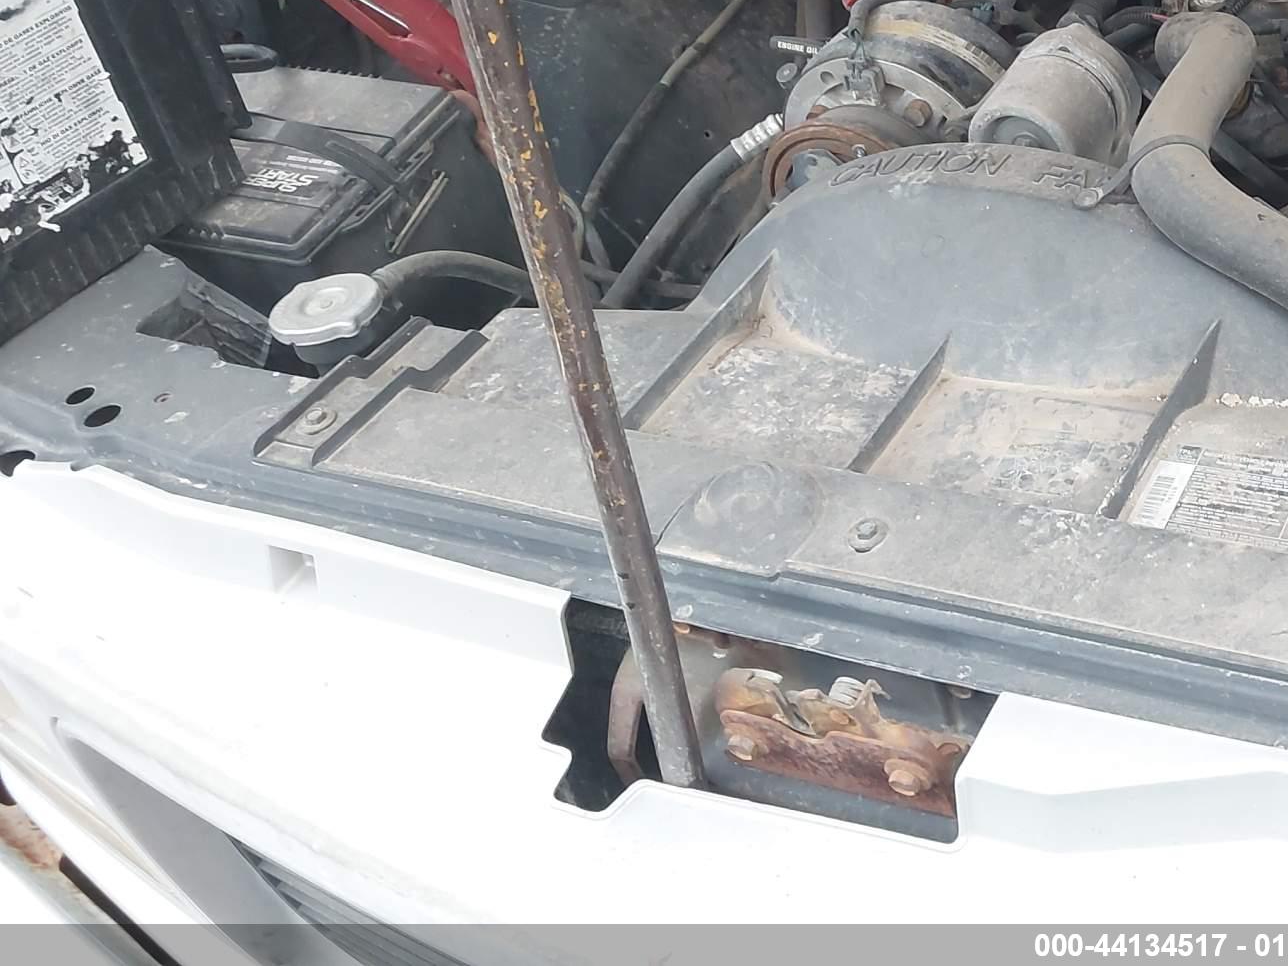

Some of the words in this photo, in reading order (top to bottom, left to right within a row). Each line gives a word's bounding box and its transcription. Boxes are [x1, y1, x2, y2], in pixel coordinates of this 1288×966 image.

[777, 40, 805, 53] ENGINE
[828, 149, 1014, 186] CAUTION
[242, 177, 298, 193] SUPER
[247, 168, 319, 186] START
